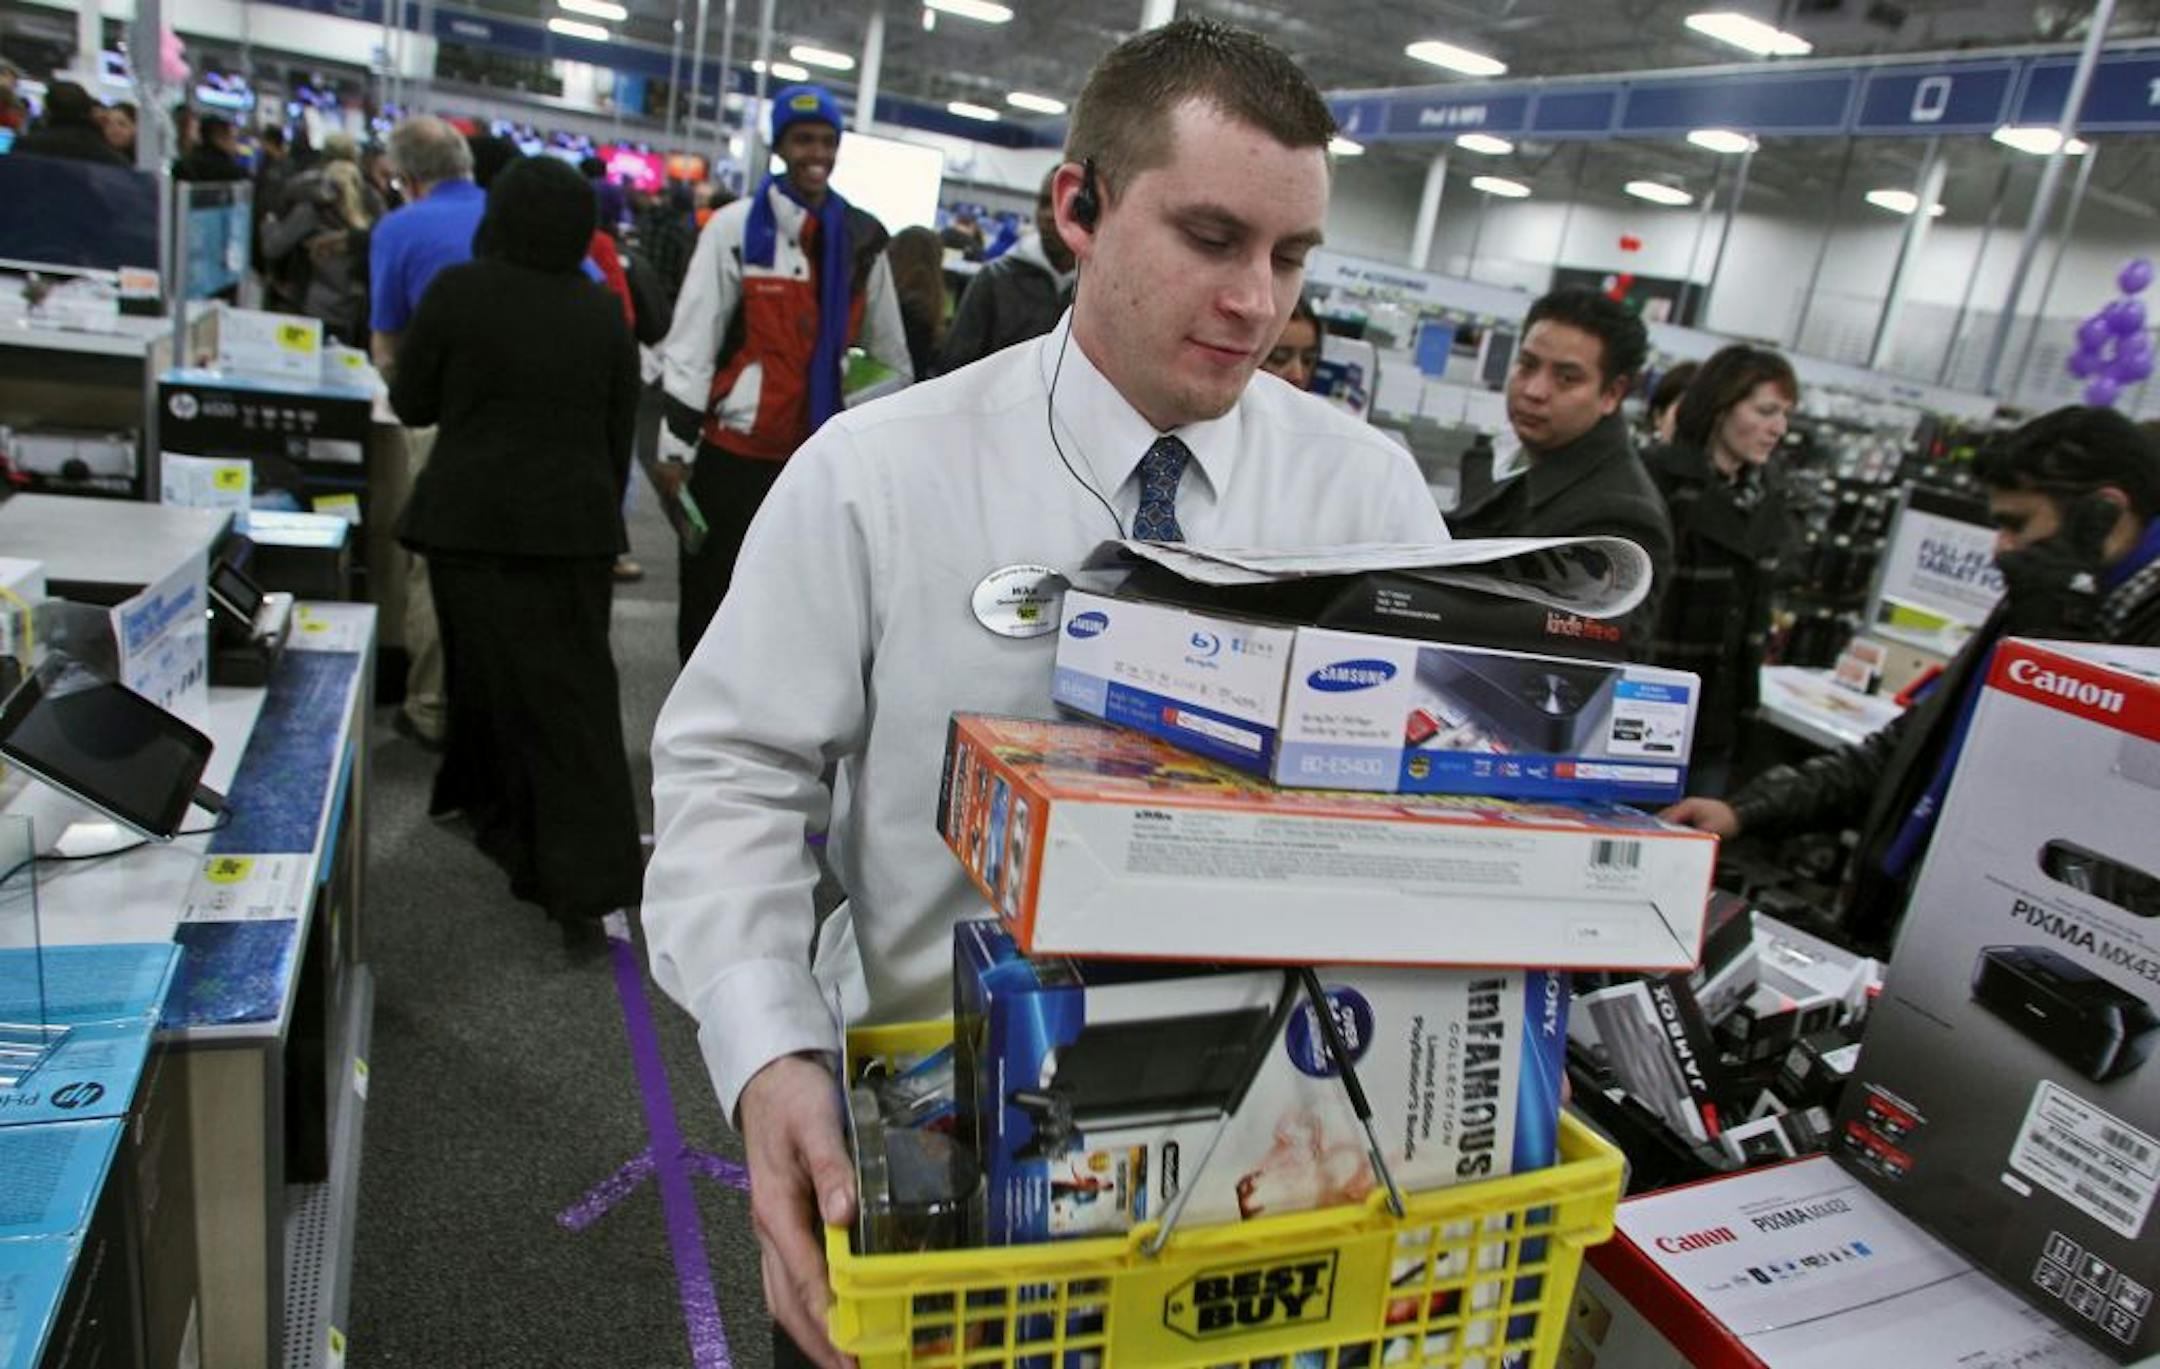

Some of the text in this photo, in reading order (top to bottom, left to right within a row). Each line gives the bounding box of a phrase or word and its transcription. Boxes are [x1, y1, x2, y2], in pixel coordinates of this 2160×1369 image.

[1316, 664, 1389, 687] SAMSUNG
[2007, 658, 2126, 713] Canon
[2009, 898, 2096, 956] PIXMA
[2098, 941, 2160, 987] MX43
[1652, 982, 1707, 1093] JAMBOX
[1421, 1034, 1439, 1142] Limited Edition
[1442, 1022, 1461, 1148] COLLECTION
[1654, 1225, 1739, 1255] Canon
[1750, 1207, 1811, 1233] PIXMA
[1193, 1259, 1329, 1306] BEST
[1196, 1292, 1315, 1333] BUY
